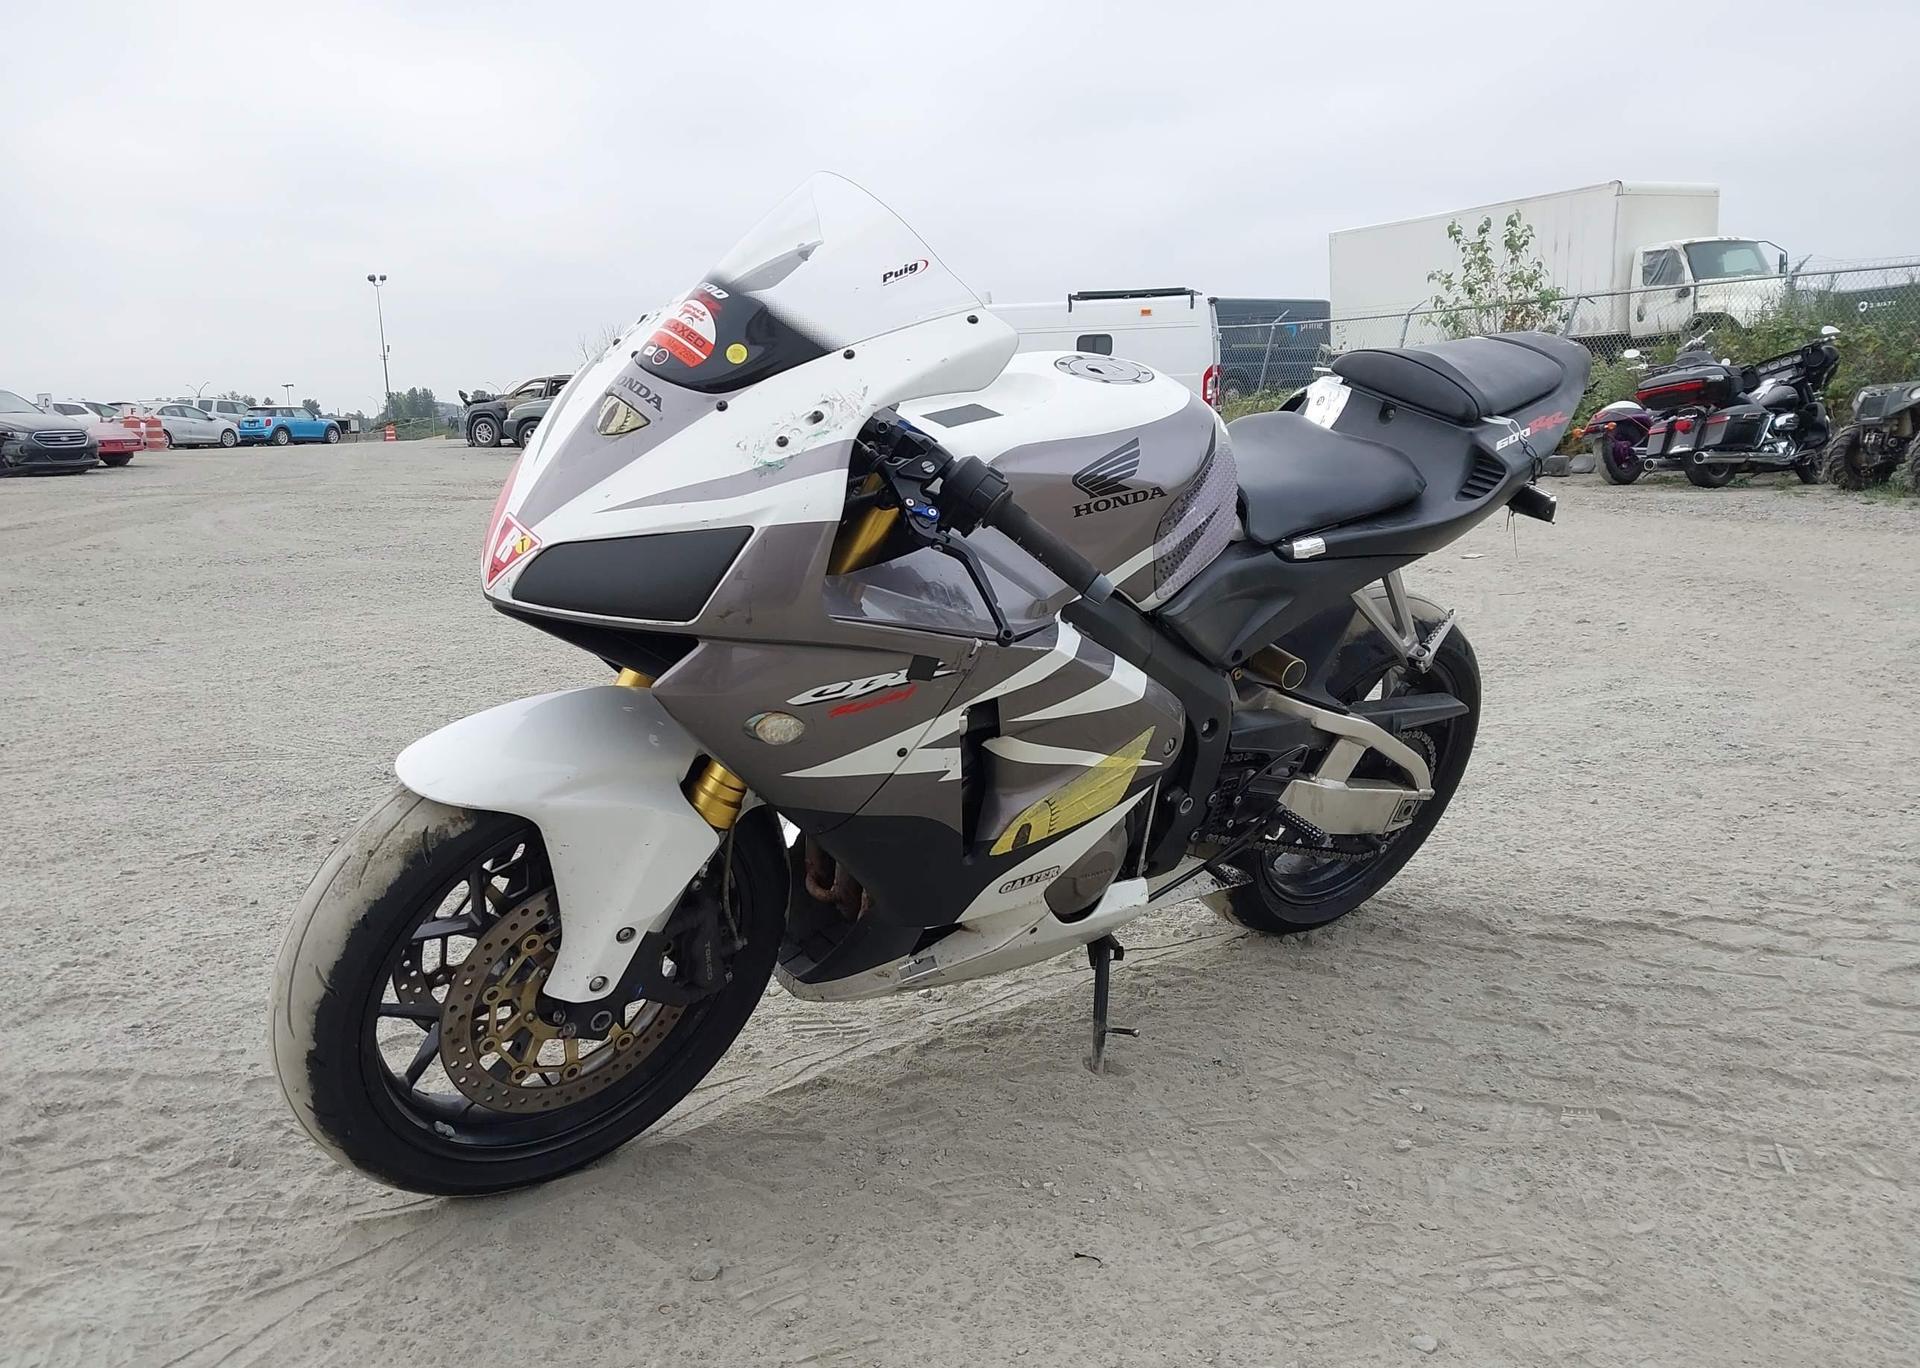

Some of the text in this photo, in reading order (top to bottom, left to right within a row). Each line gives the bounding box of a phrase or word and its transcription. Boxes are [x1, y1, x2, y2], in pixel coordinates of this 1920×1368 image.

[883, 262, 918, 283] Puig
[617, 375, 663, 412] ONDA
[130, 407, 139, 415] F
[1072, 486, 1168, 518] HONDA
[999, 867, 1060, 894] GALFER
